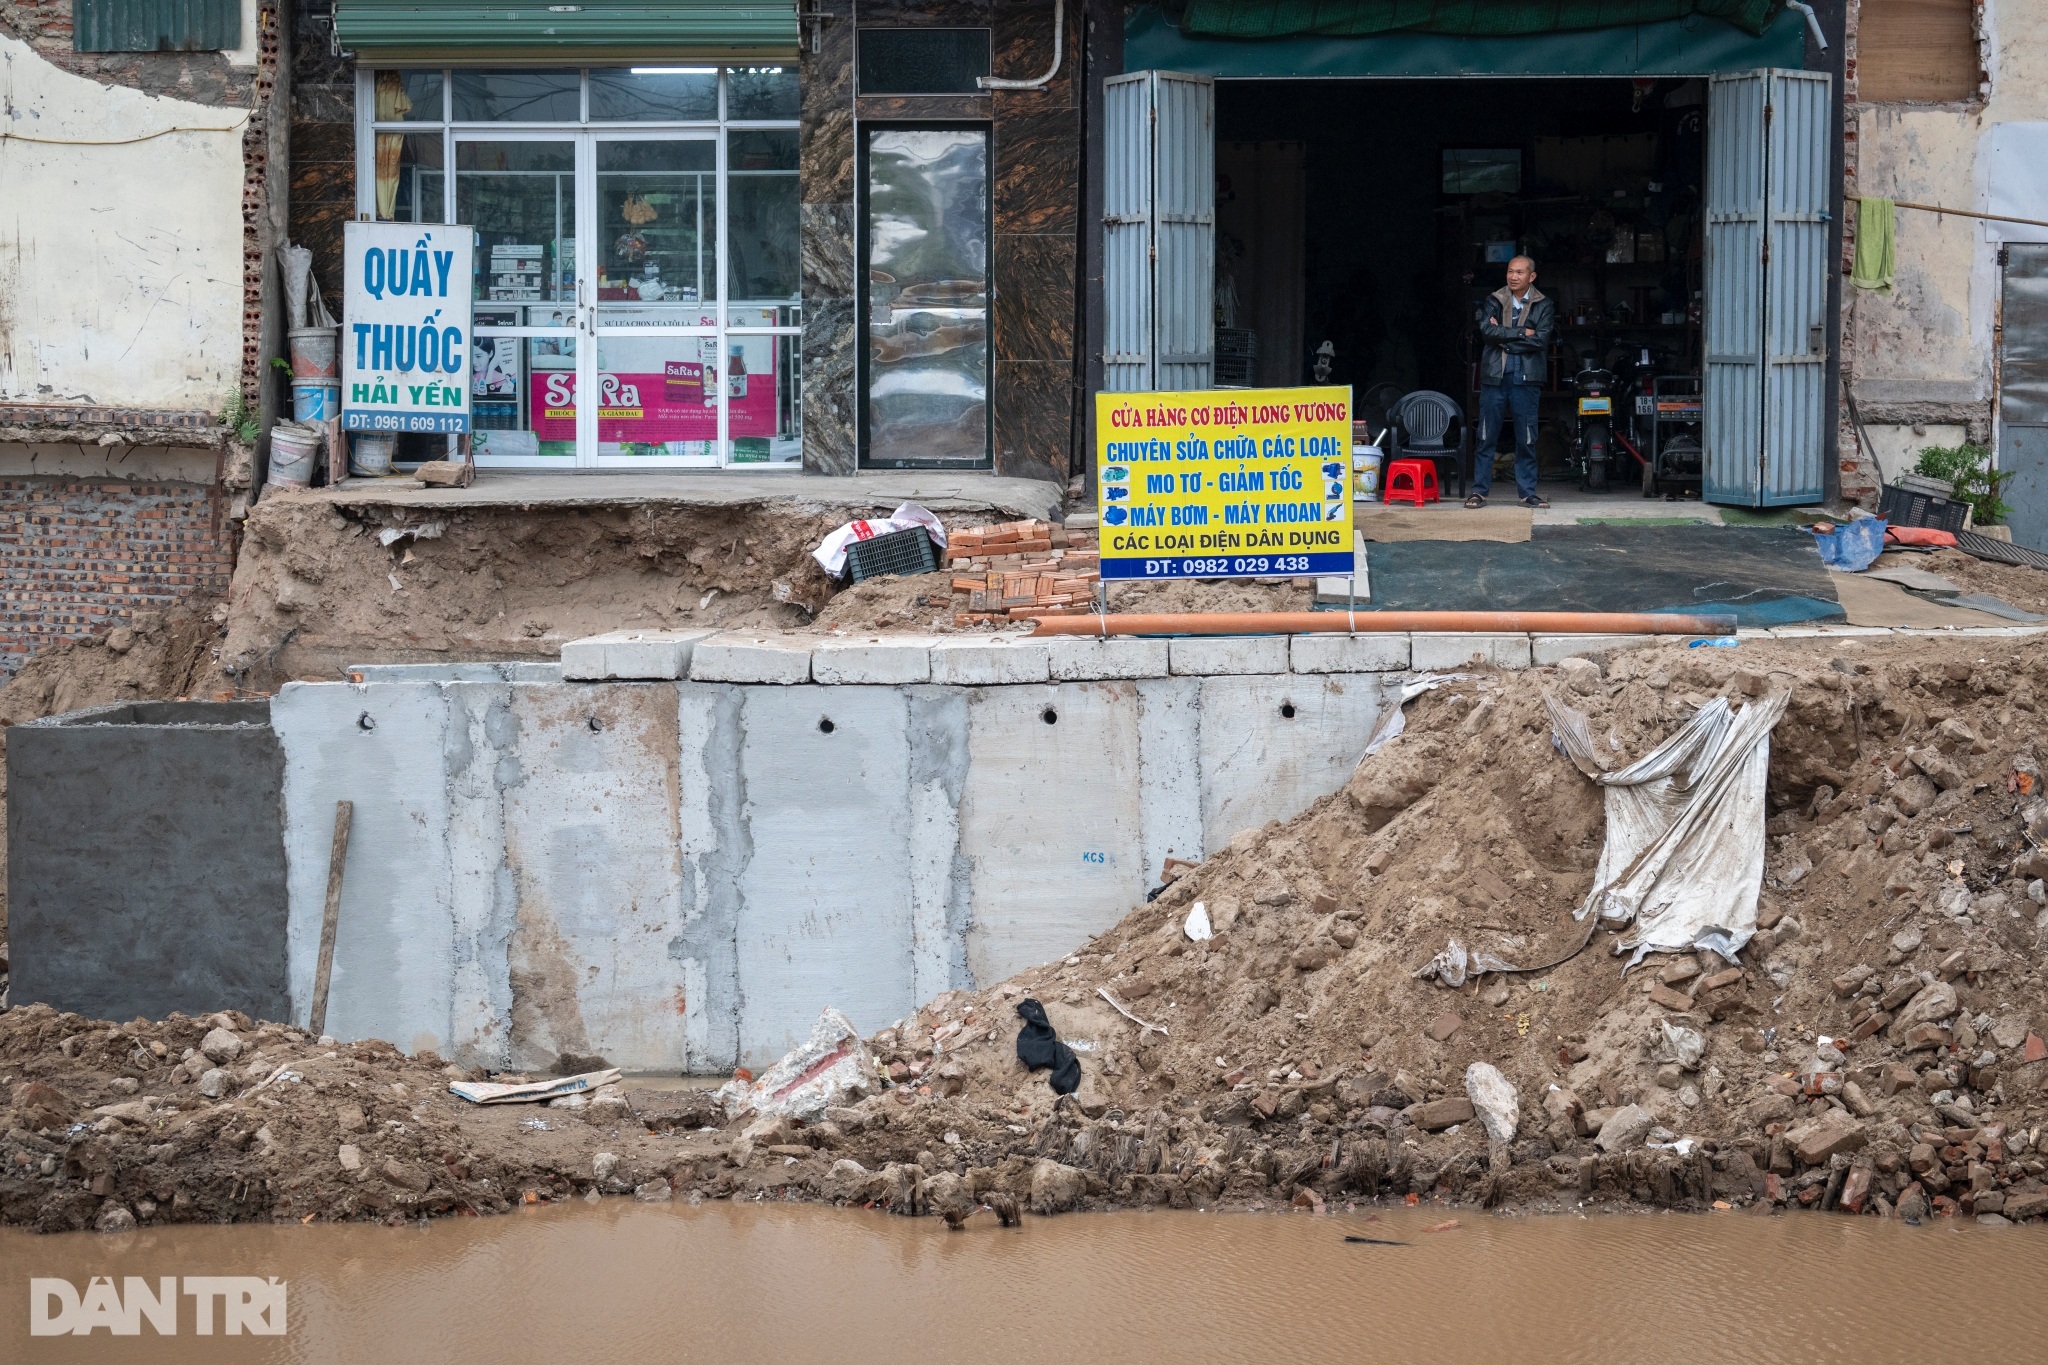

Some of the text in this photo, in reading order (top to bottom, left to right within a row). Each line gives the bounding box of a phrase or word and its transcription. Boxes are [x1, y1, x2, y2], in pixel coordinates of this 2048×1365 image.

[364, 233, 454, 300] QUẦY
[353, 309, 462, 374] THUỐC
[667, 366, 692, 376] SaRa
[352, 376, 462, 406] HẢI YẾN
[544, 373, 642, 407] SRa
[348, 414, 462, 432] ĐT: 0961 609 112
[1112, 400, 1347, 429] CỬA HÀNG CƠ ĐIỆN LONG VƯƠNG
[1107, 432, 1342, 462] CHUYÊN SỬA CHỮA CÁC LOẠI:
[1147, 474, 1177, 494] MO
[1180, 472, 1202, 493] TƠ
[1218, 464, 1264, 492] GIẢM
[1268, 464, 1302, 490] TỐC
[1130, 502, 1166, 527] MÁY
[1170, 505, 1208, 526] BƠM
[1224, 500, 1260, 525] MÁY
[1265, 502, 1321, 523] KHOAN
[1113, 529, 1340, 553] CÁC LOẠI ĐIỆN DÂN DỤNG
[1145, 556, 1310, 574] ĐT: 0982 029 438
[1083, 852, 1104, 863] KCS
